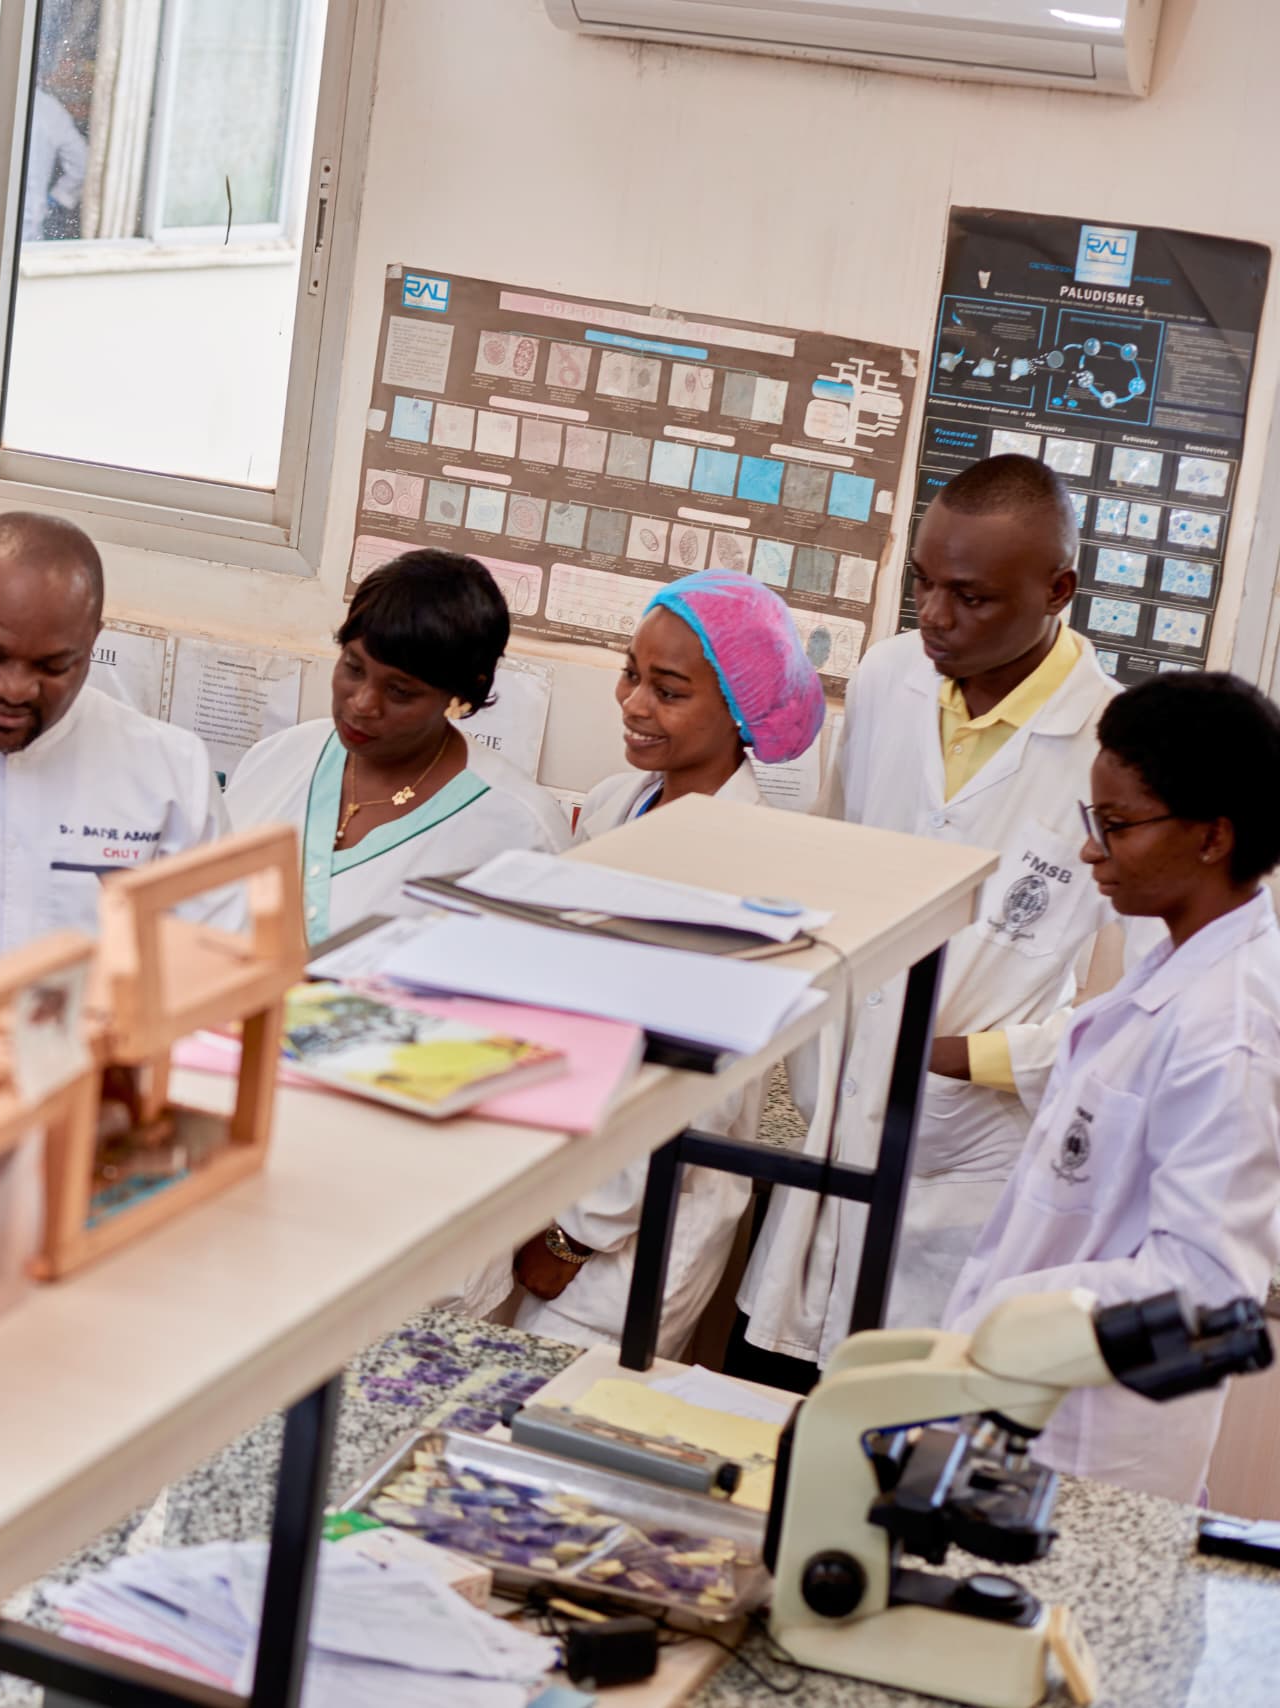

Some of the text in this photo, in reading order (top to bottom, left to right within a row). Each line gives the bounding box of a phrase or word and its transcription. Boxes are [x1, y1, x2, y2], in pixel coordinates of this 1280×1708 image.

[1087, 237, 1127, 257] RAL
[404, 279, 449, 301] RAL
[1059, 286, 1145, 307] PALUDISMES
[934, 428, 978, 440] Plasmodium
[1022, 849, 1073, 884] FMSB
